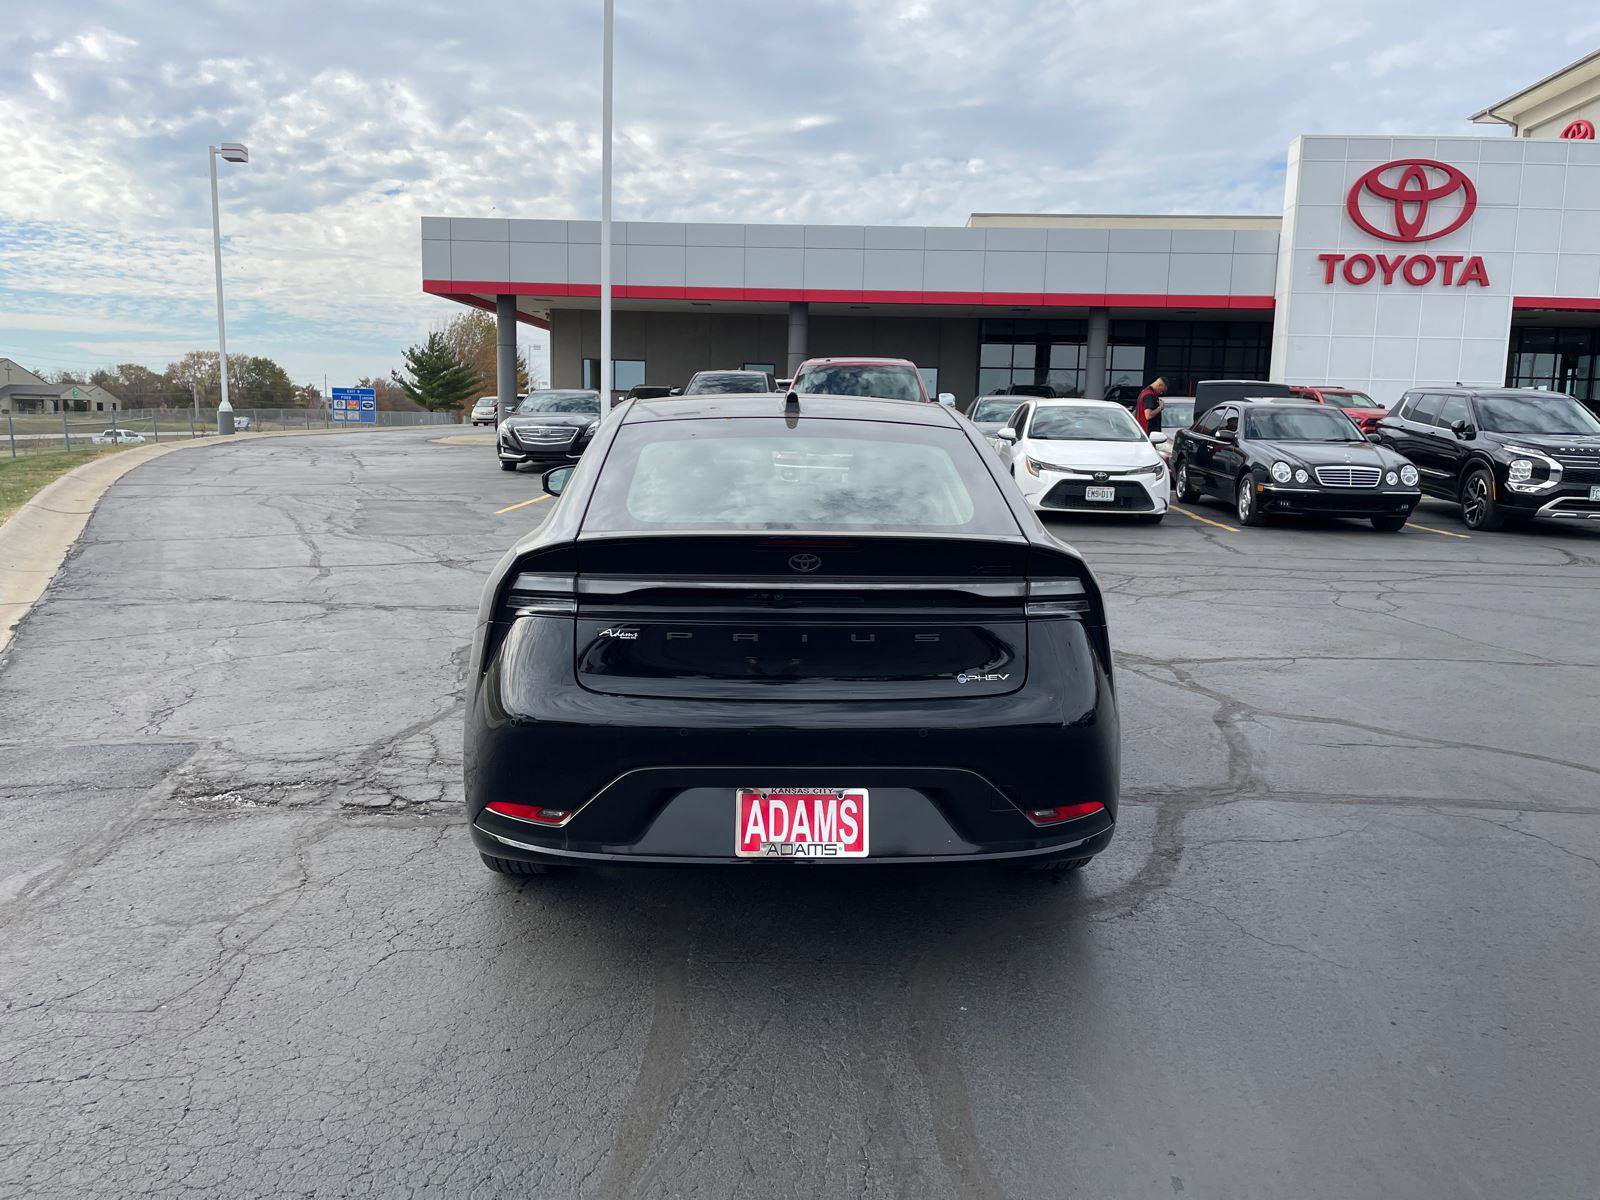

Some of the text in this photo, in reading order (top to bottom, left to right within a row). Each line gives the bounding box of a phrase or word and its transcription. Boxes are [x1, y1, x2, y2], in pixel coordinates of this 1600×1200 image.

[1318, 253, 1490, 286] TOYOTA
[666, 631, 940, 643] PRIUS
[744, 800, 859, 845] ADAMS
[766, 843, 837, 856] ADAMS
